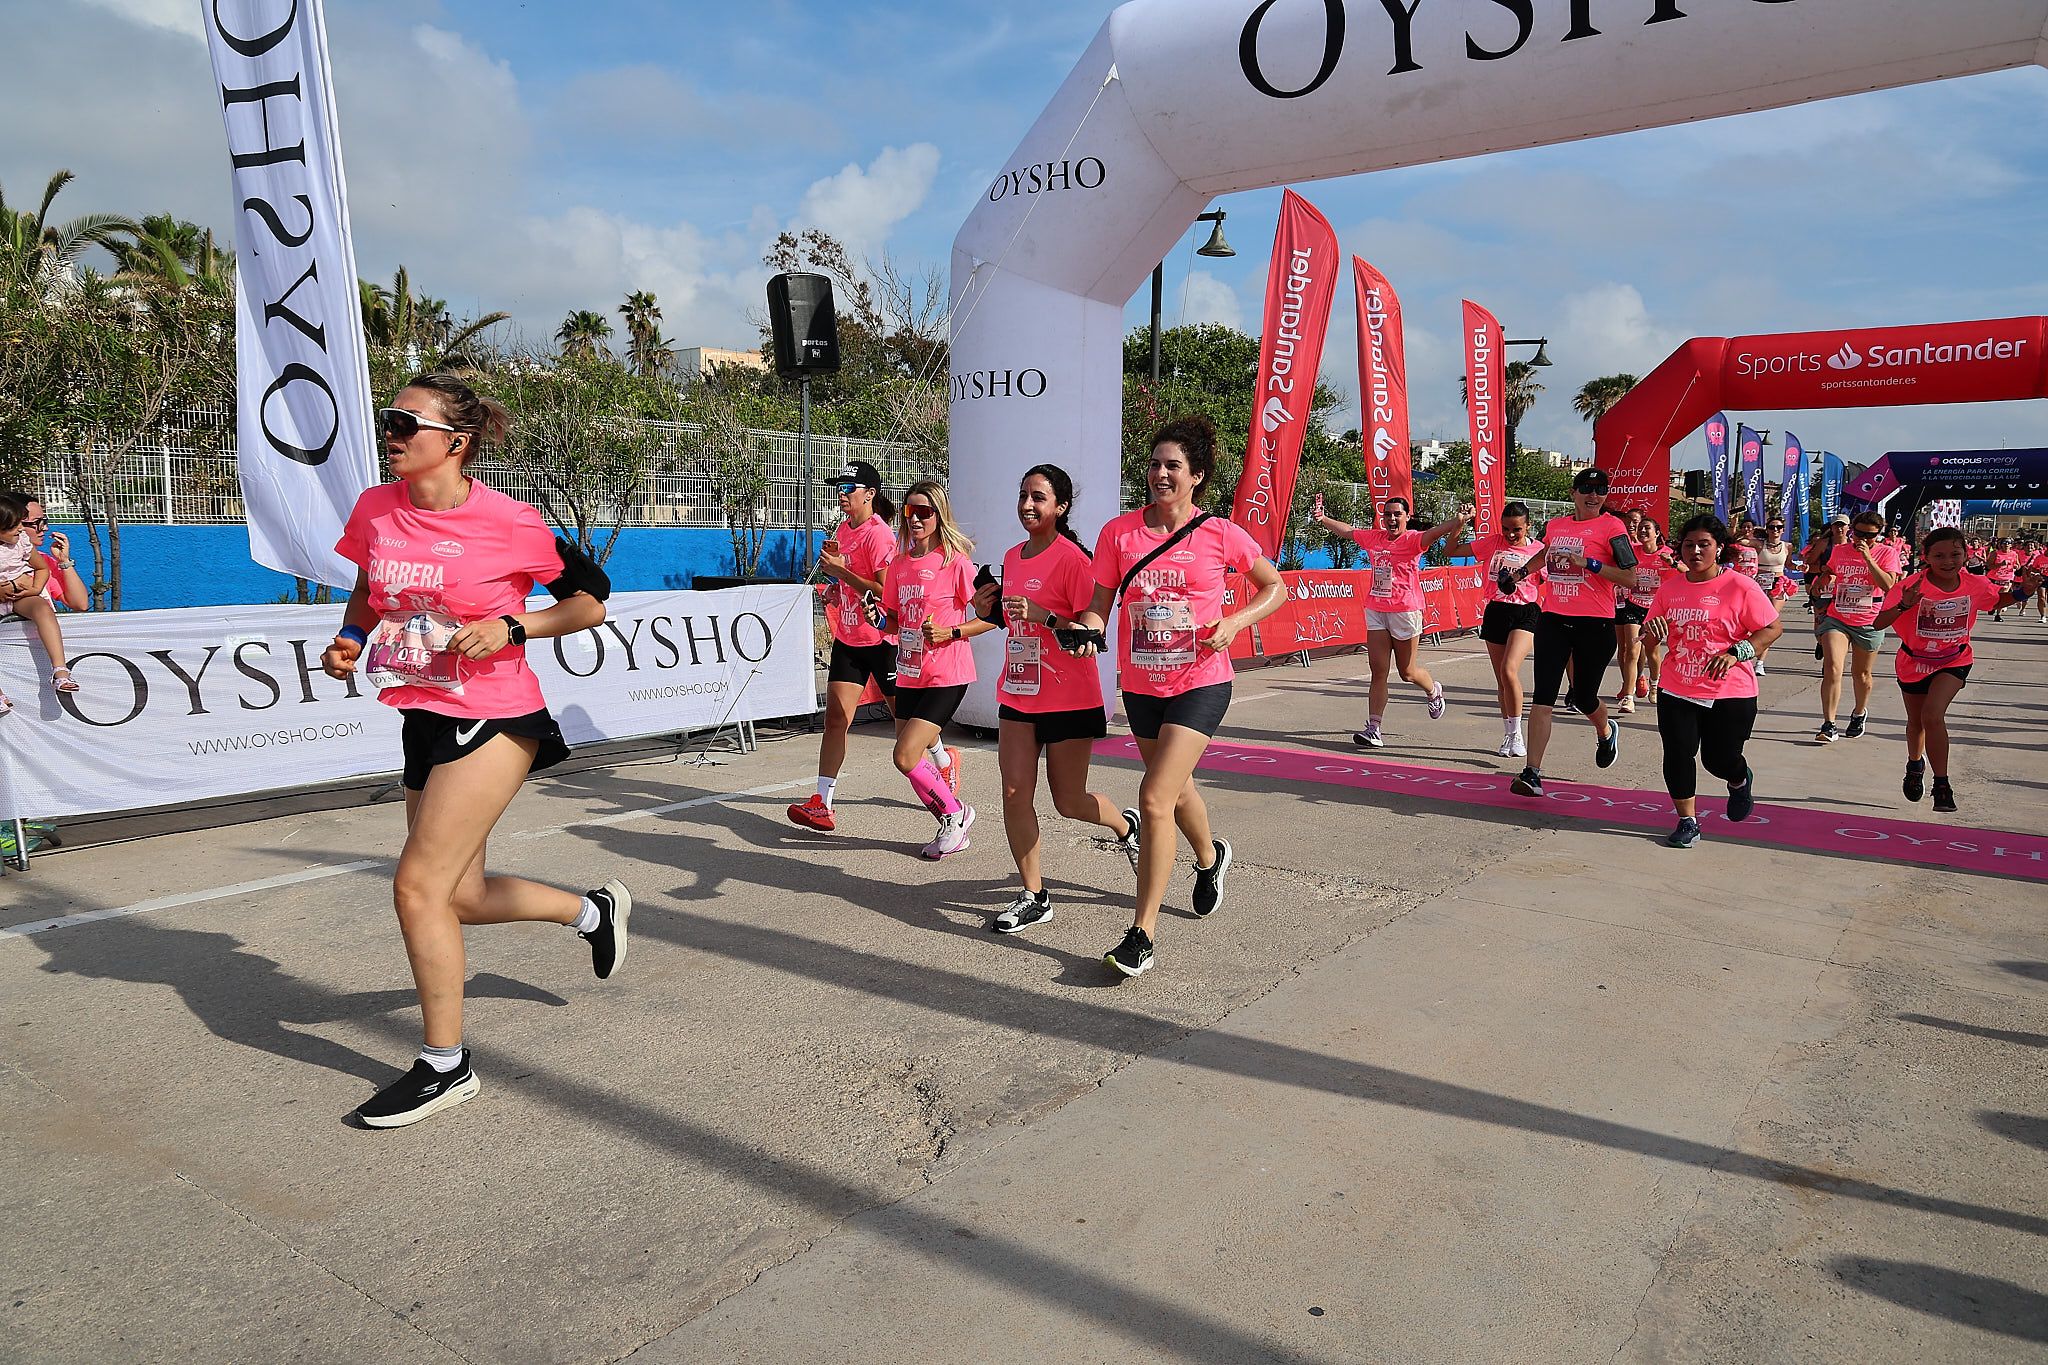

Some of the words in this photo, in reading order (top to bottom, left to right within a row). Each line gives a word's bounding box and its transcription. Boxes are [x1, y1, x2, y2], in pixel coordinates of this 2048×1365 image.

[1239, 0, 1802, 99] OYS
[989, 157, 1106, 202] OYSHO
[1736, 351, 1821, 379] Sports
[1867, 337, 2027, 368] Santander
[1820, 375, 1917, 391] sportssantander.es
[1942, 456, 1982, 466] octopus
[1982, 456, 2018, 466] energy
[1608, 467, 1642, 479] Sports
[374, 535, 407, 549] OYSHO
[368, 558, 445, 590] CARRERA
[1131, 569, 1187, 588] ARRERA
[1836, 565, 1870, 576] CARRERA
[1308, 580, 1355, 599] Santander
[1419, 577, 1444, 593] ntander
[1665, 608, 1710, 622] CARRERA
[1935, 617, 1956, 625] 016
[1147, 630, 1172, 642] 016
[1686, 625, 1701, 641] DE
[553, 612, 773, 677] OYSHO
[397, 648, 432, 664] 016
[1010, 663, 1025, 673] 16
[55, 640, 364, 727] OYSH
[374, 675, 406, 684] OYSHO
[1149, 673, 1166, 682] 2026
[628, 681, 729, 702] WWW.OYSHO.COM
[188, 721, 364, 756] WWW.OYSHO.COM
[1314, 765, 1497, 791] OYSHO
